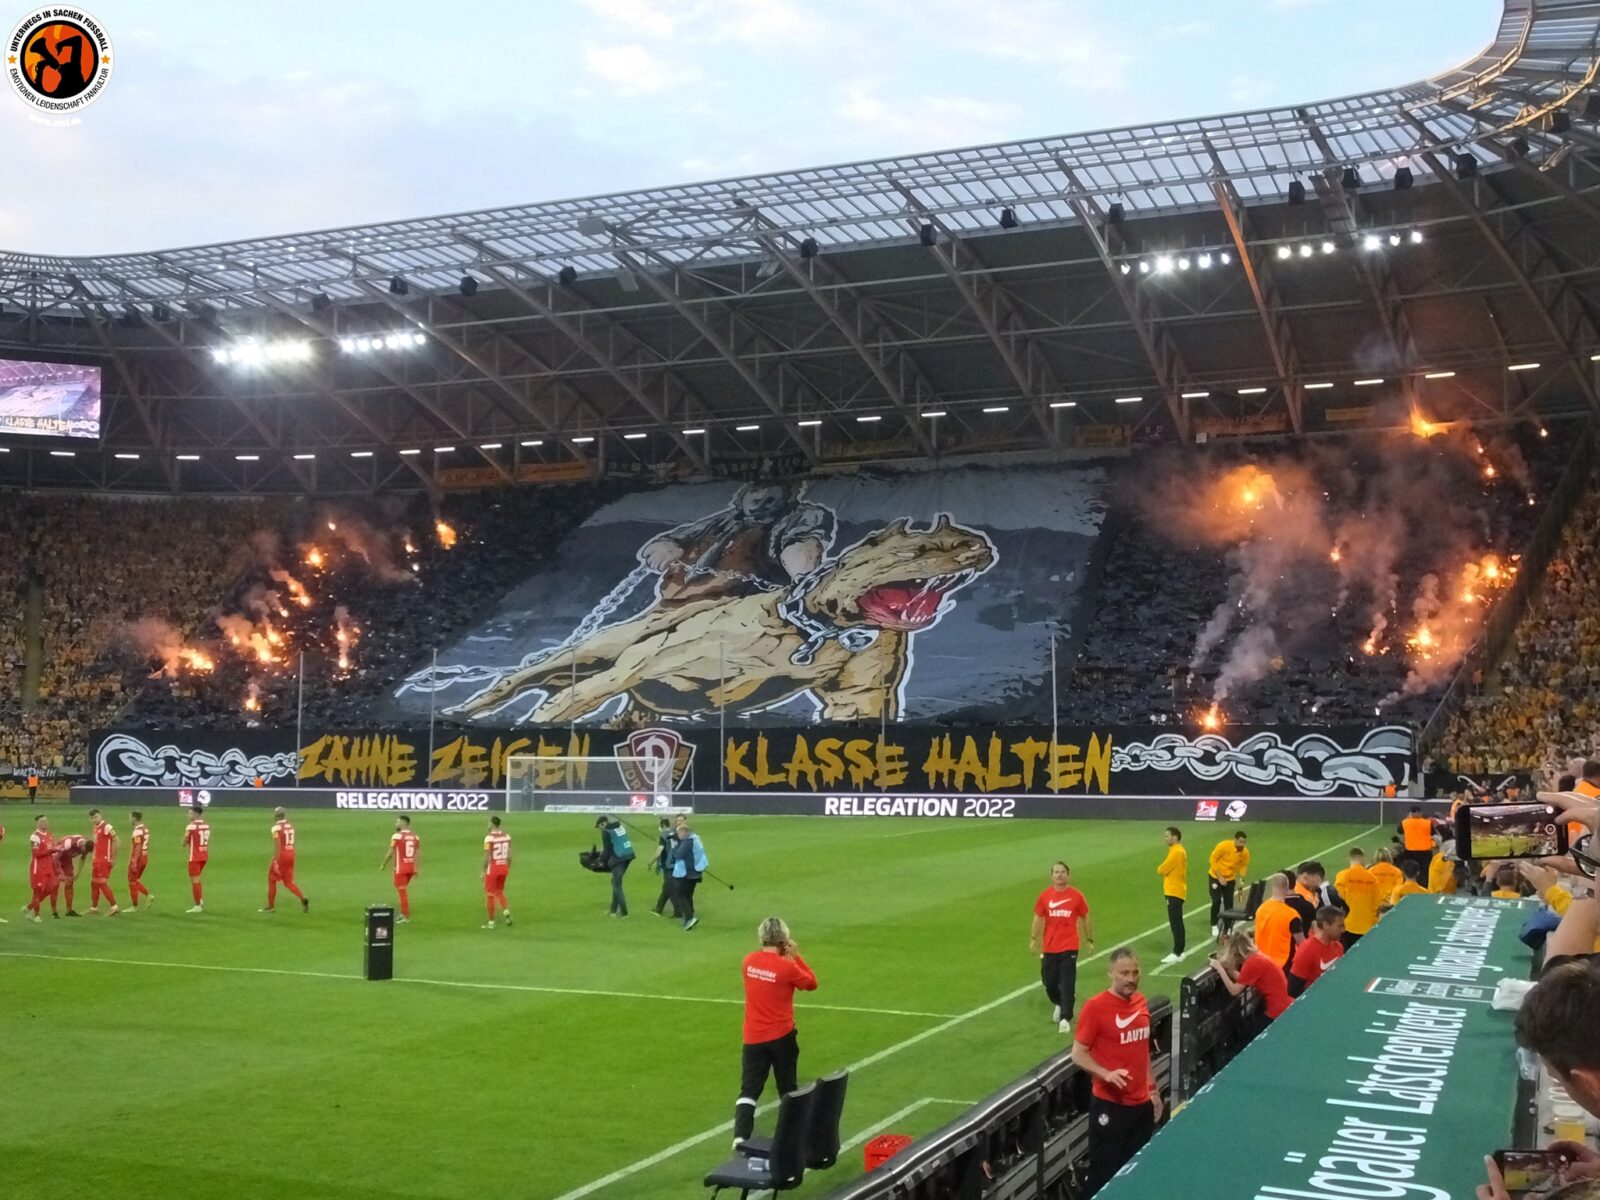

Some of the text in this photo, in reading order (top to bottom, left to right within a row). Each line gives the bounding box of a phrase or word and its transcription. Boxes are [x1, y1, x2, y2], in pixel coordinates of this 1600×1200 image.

[296, 732, 417, 787] ZÄHNE
[427, 732, 590, 789] ZEIGEN
[724, 731, 909, 792] KLASSE
[921, 731, 1112, 794] HALTEN
[336, 791, 489, 810] RELEGATION 2022
[825, 796, 1015, 818] RELEGATION 2022
[198, 829, 210, 846] 19
[283, 828, 295, 845] 13
[405, 840, 415, 857] 6
[1429, 906, 1502, 948] Latschenkiefer
[1408, 945, 1503, 981] Allgäuer
[1326, 1001, 1467, 1115] Latschenkiefer
